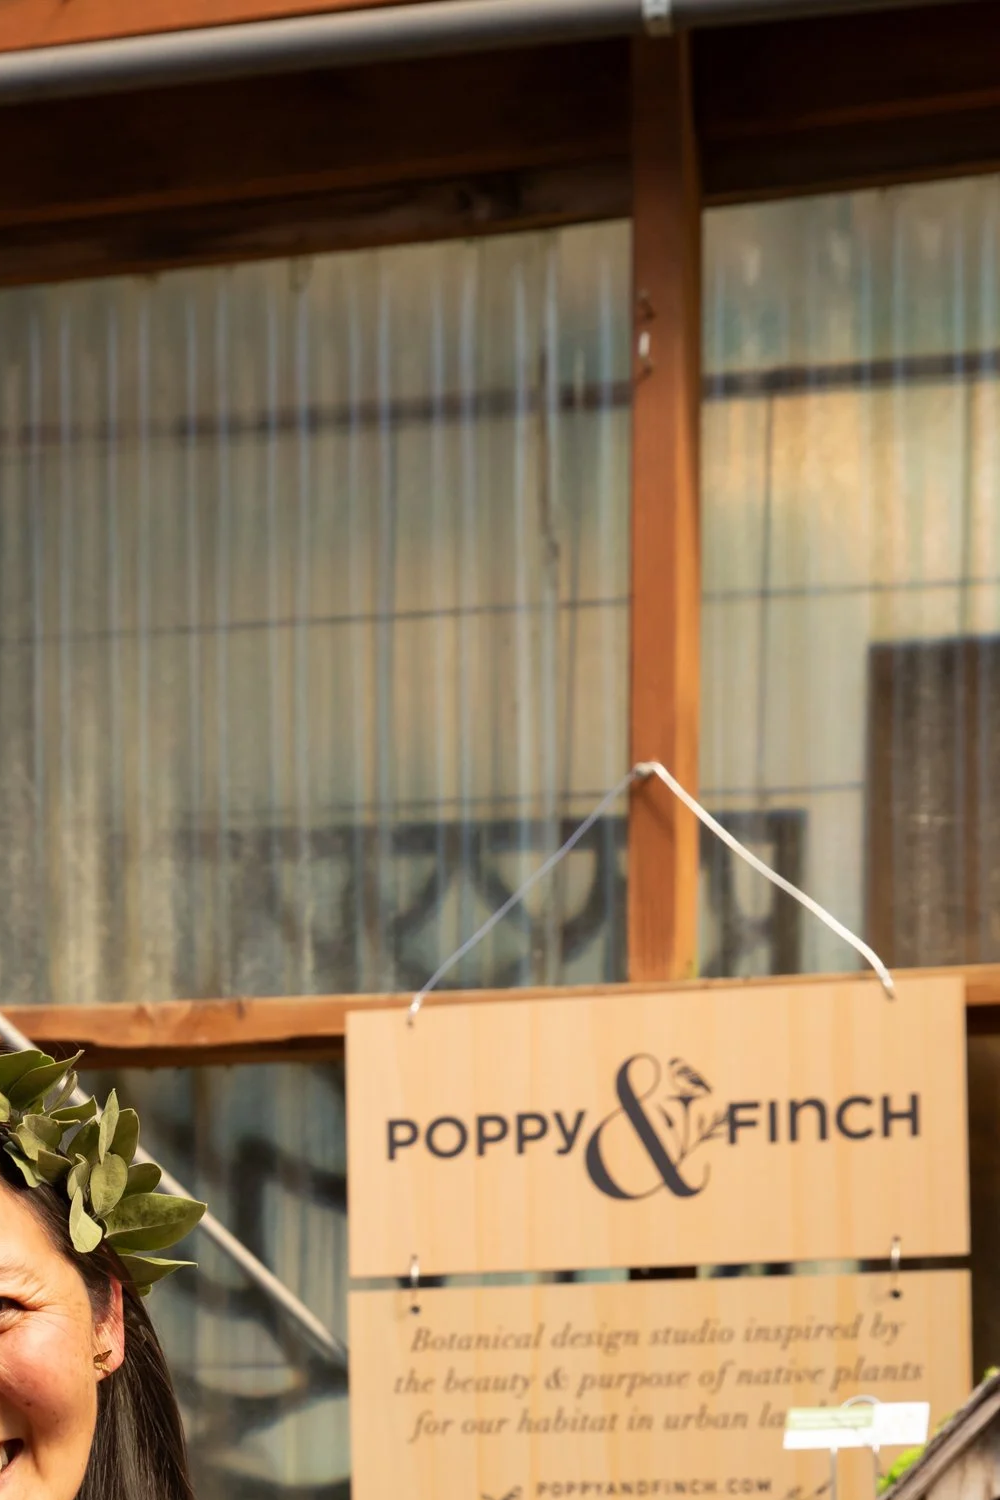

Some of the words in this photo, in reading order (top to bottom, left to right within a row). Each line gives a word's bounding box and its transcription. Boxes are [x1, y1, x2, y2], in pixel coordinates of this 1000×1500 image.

[387, 1109, 587, 1161] POPPY
[585, 1052, 712, 1201] &
[411, 1322, 544, 1352] Botanical
[551, 1322, 640, 1356] design
[649, 1317, 735, 1346] studio
[744, 1312, 863, 1350] inspired
[869, 1311, 905, 1345] by
[393, 1367, 436, 1395] the
[443, 1367, 532, 1399] beauty
[544, 1366, 568, 1391] &
[575, 1365, 690, 1399] purpose
[698, 1359, 735, 1395] of
[736, 1358, 823, 1386] native
[828, 1355, 924, 1393] plants
[408, 1409, 455, 1444] for
[460, 1416, 511, 1435] our
[516, 1407, 619, 1434] habitat
[626, 1405, 655, 1432] in
[663, 1403, 750, 1431] urban
[535, 1478, 772, 1498] POPPYANDFINCH.COM
